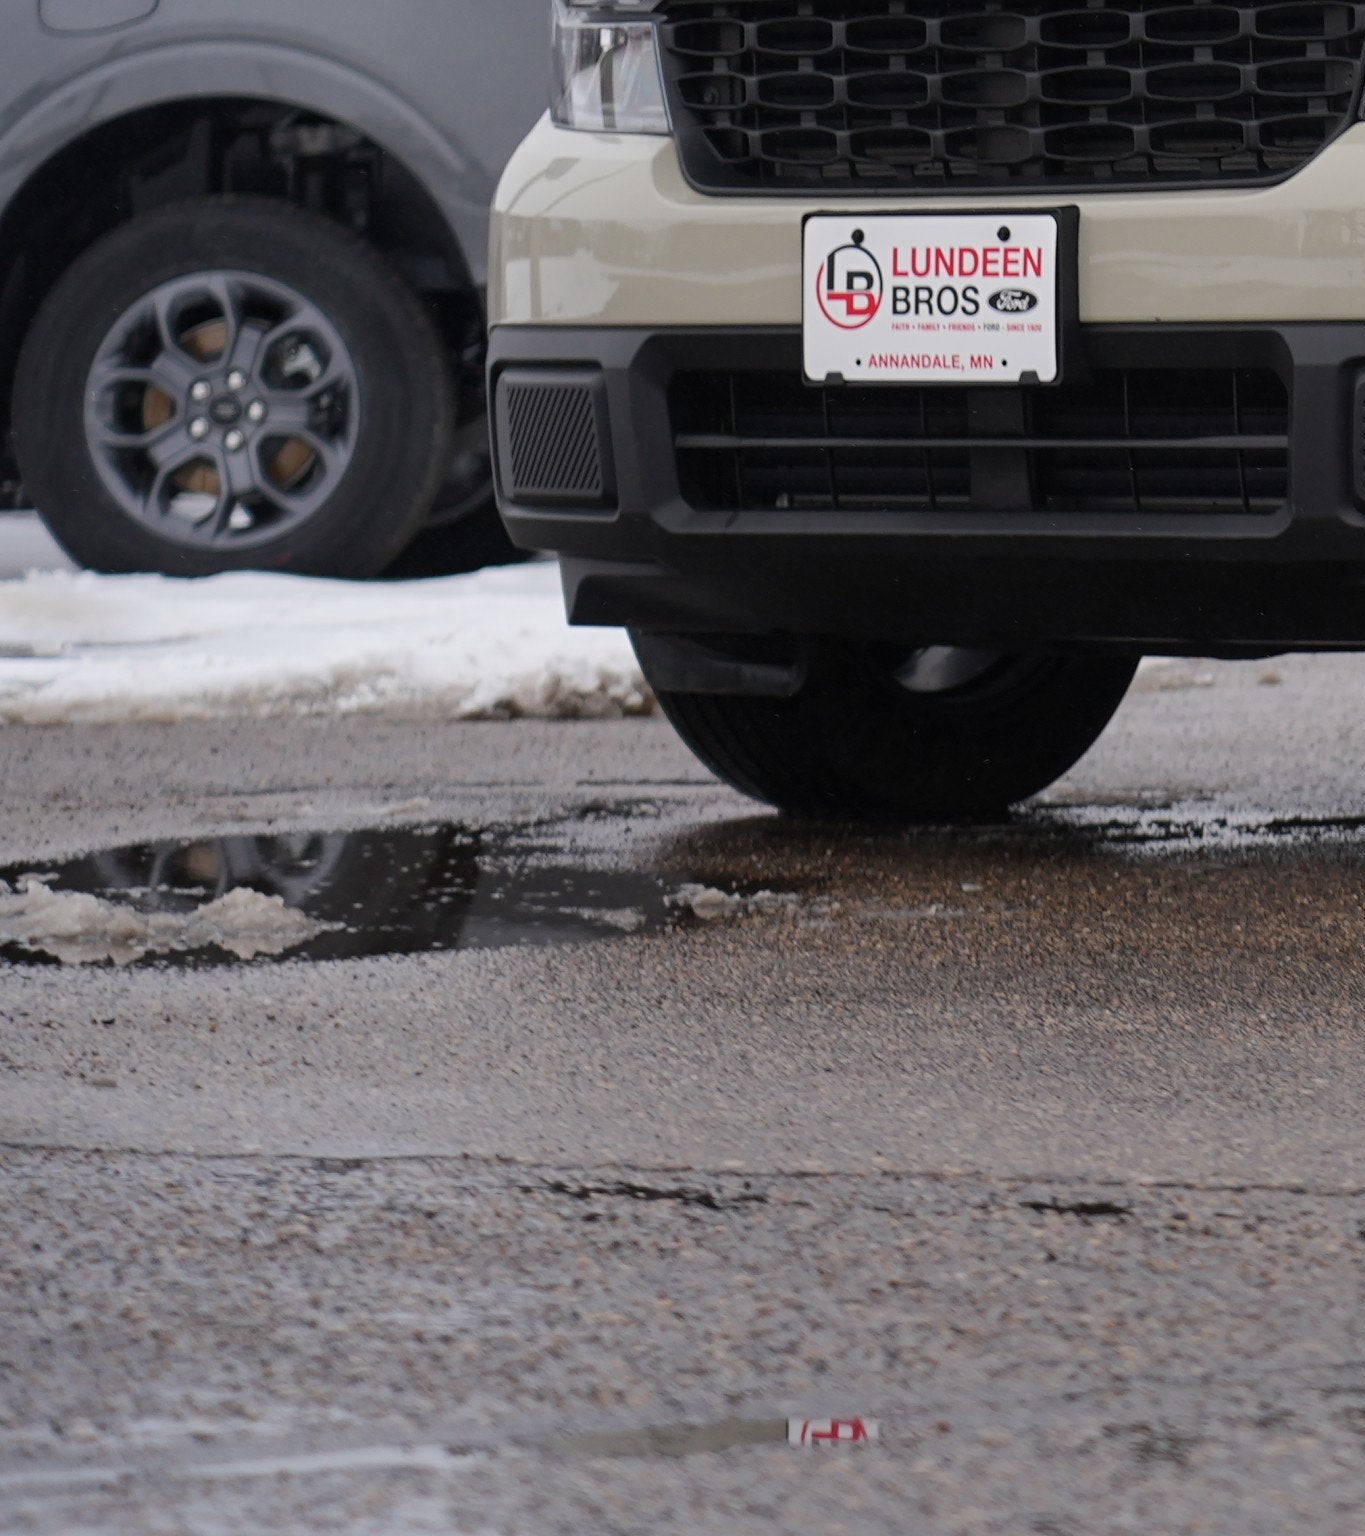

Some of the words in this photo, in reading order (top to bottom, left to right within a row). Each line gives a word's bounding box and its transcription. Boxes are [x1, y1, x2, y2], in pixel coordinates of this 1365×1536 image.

[892, 247, 1043, 277] LUNDEEN
[892, 285, 980, 315] BROS
[995, 289, 1031, 311] Ford
[868, 353, 965, 371] ANNANDALE,
[970, 354, 994, 369] MN
